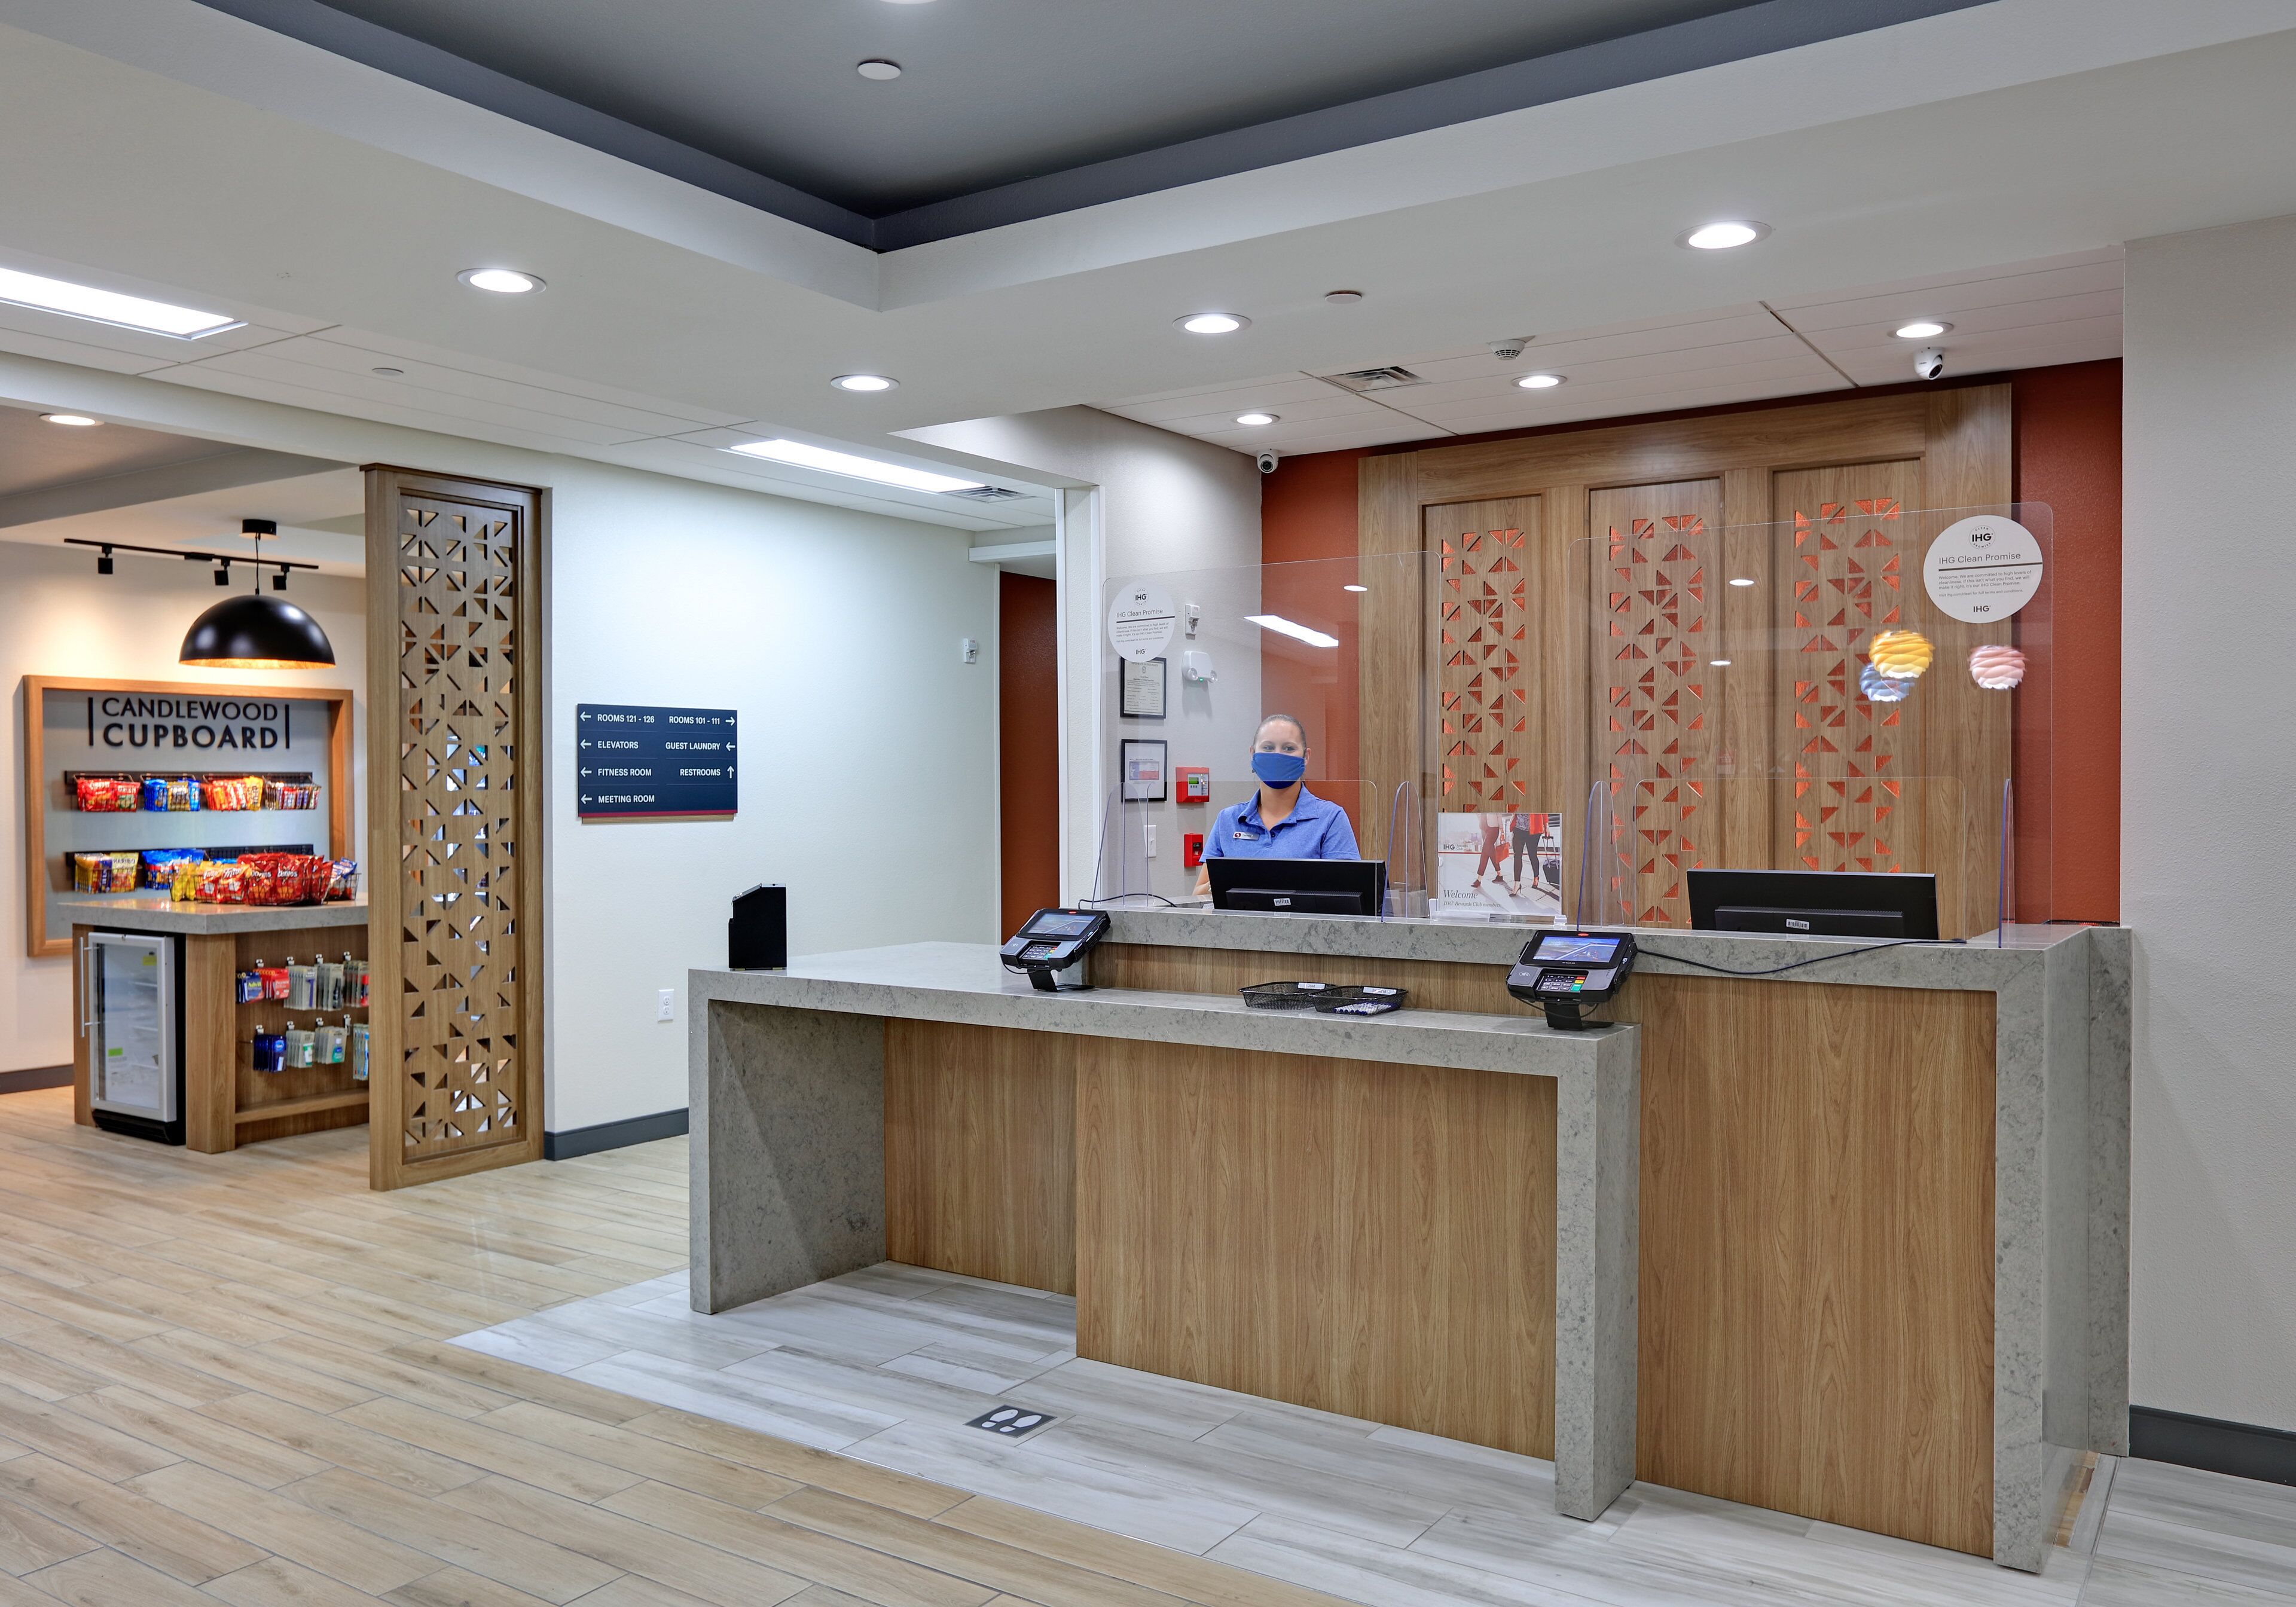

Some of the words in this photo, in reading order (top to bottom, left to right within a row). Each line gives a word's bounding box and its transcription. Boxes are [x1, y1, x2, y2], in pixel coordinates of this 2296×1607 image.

[1972, 533, 1992, 542] IHG
[1985, 552, 2021, 561] Promise
[102, 697, 278, 721] CANDLEWOOD
[597, 714, 625, 723] ROOMS
[103, 723, 278, 748] CUPBOARD
[598, 741, 639, 749] ELEVATORS
[665, 742, 688, 750] GUEST
[598, 768, 628, 777] FITNESS
[630, 768, 652, 777] ROOM
[598, 795, 631, 804] MEETING
[633, 795, 655, 803] ROOM
[1443, 890, 1478, 899] Welcome
